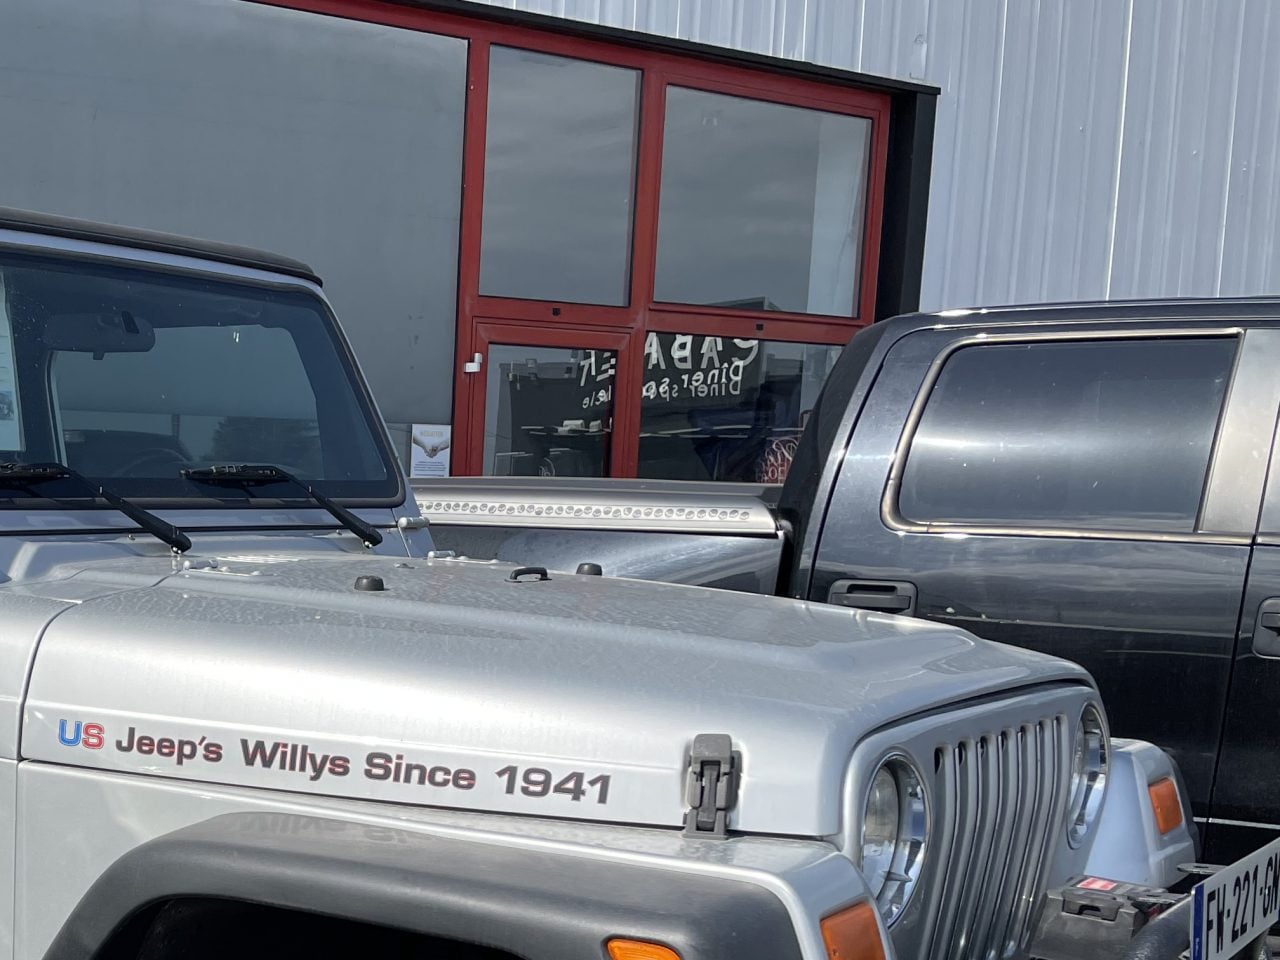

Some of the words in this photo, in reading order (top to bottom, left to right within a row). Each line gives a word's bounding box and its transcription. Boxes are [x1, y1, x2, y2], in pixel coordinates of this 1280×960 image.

[58, 718, 104, 749] US
[115, 727, 223, 763] Jeep's
[240, 739, 351, 781] Willys
[363, 751, 476, 790] Since
[494, 764, 611, 805] 1941
